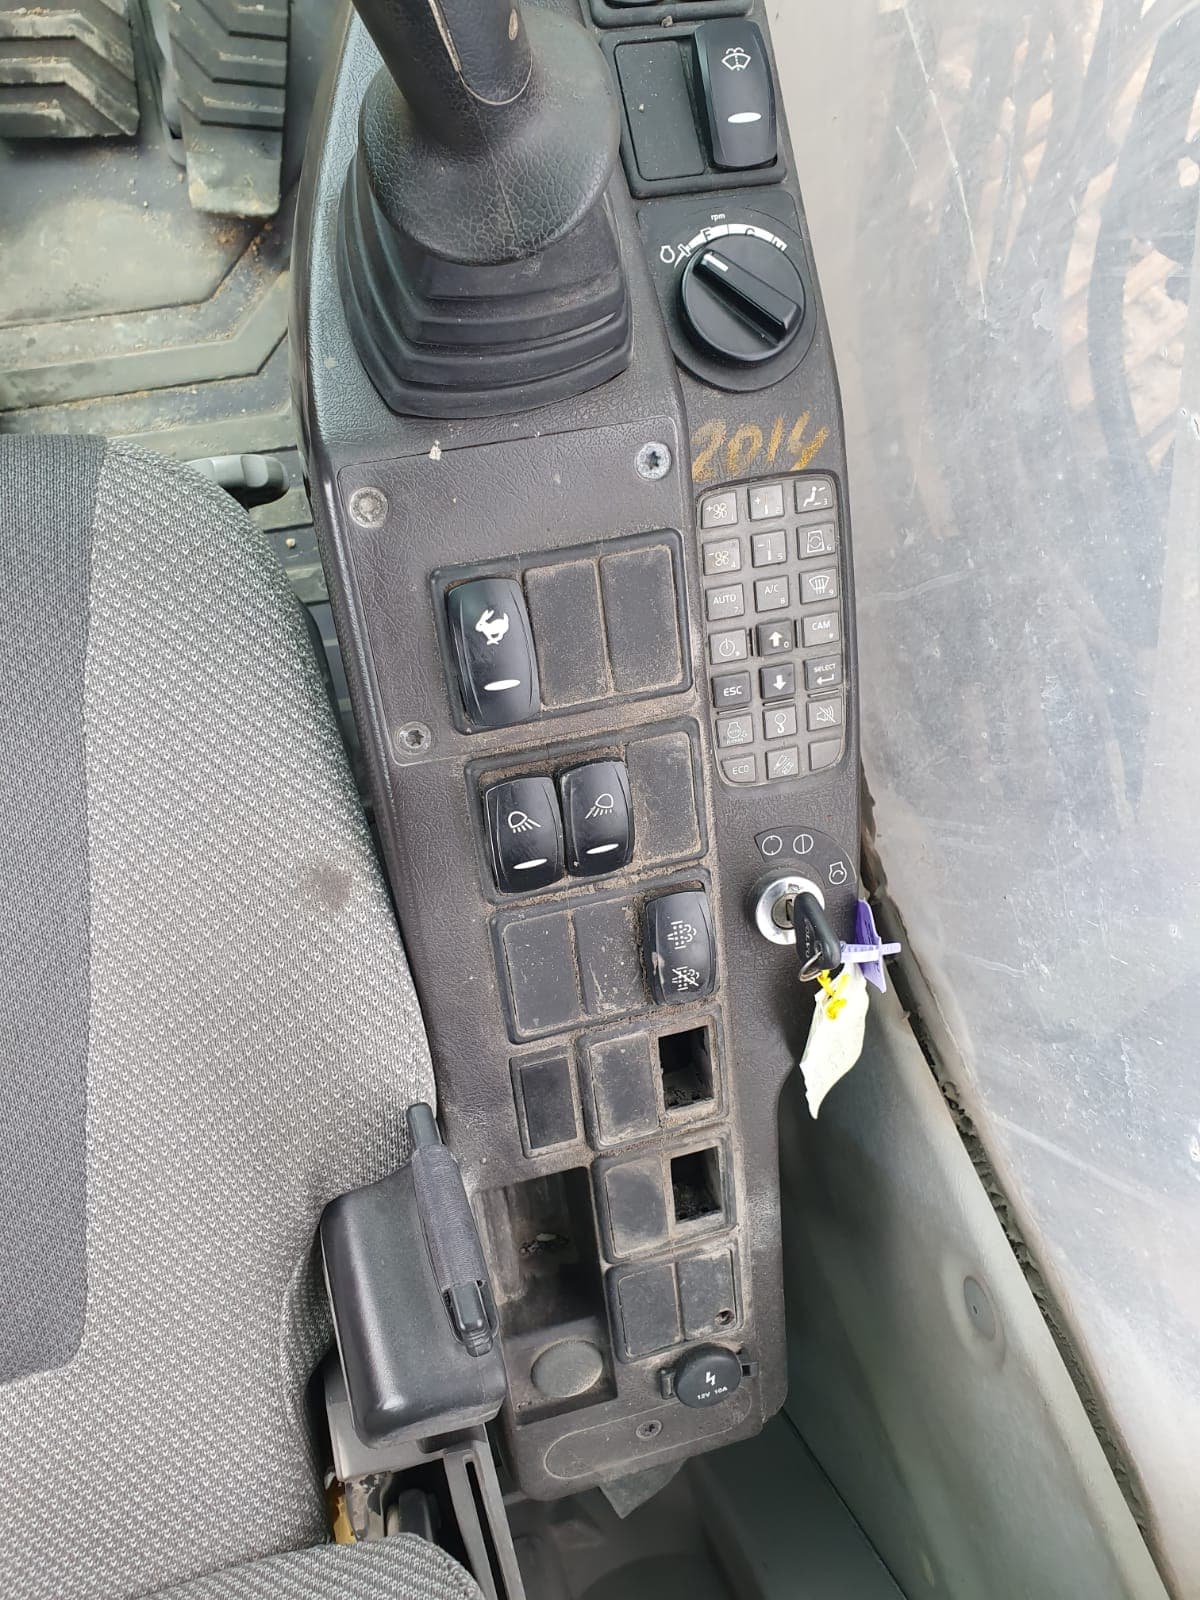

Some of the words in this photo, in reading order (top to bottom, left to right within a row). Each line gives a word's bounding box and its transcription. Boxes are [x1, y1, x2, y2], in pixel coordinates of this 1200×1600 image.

[711, 213, 726, 222] rpm
[702, 228, 712, 241] F
[691, 409, 829, 482] 2014
[764, 584, 779, 594] A/C
[713, 593, 737, 605] AUTO
[812, 620, 831, 631] CAM
[814, 663, 836, 673] SELECT
[723, 685, 743, 697] ESC
[732, 764, 749, 775] ECO
[697, 1391, 711, 1400] 12V
[714, 1386, 728, 1395] 10A
